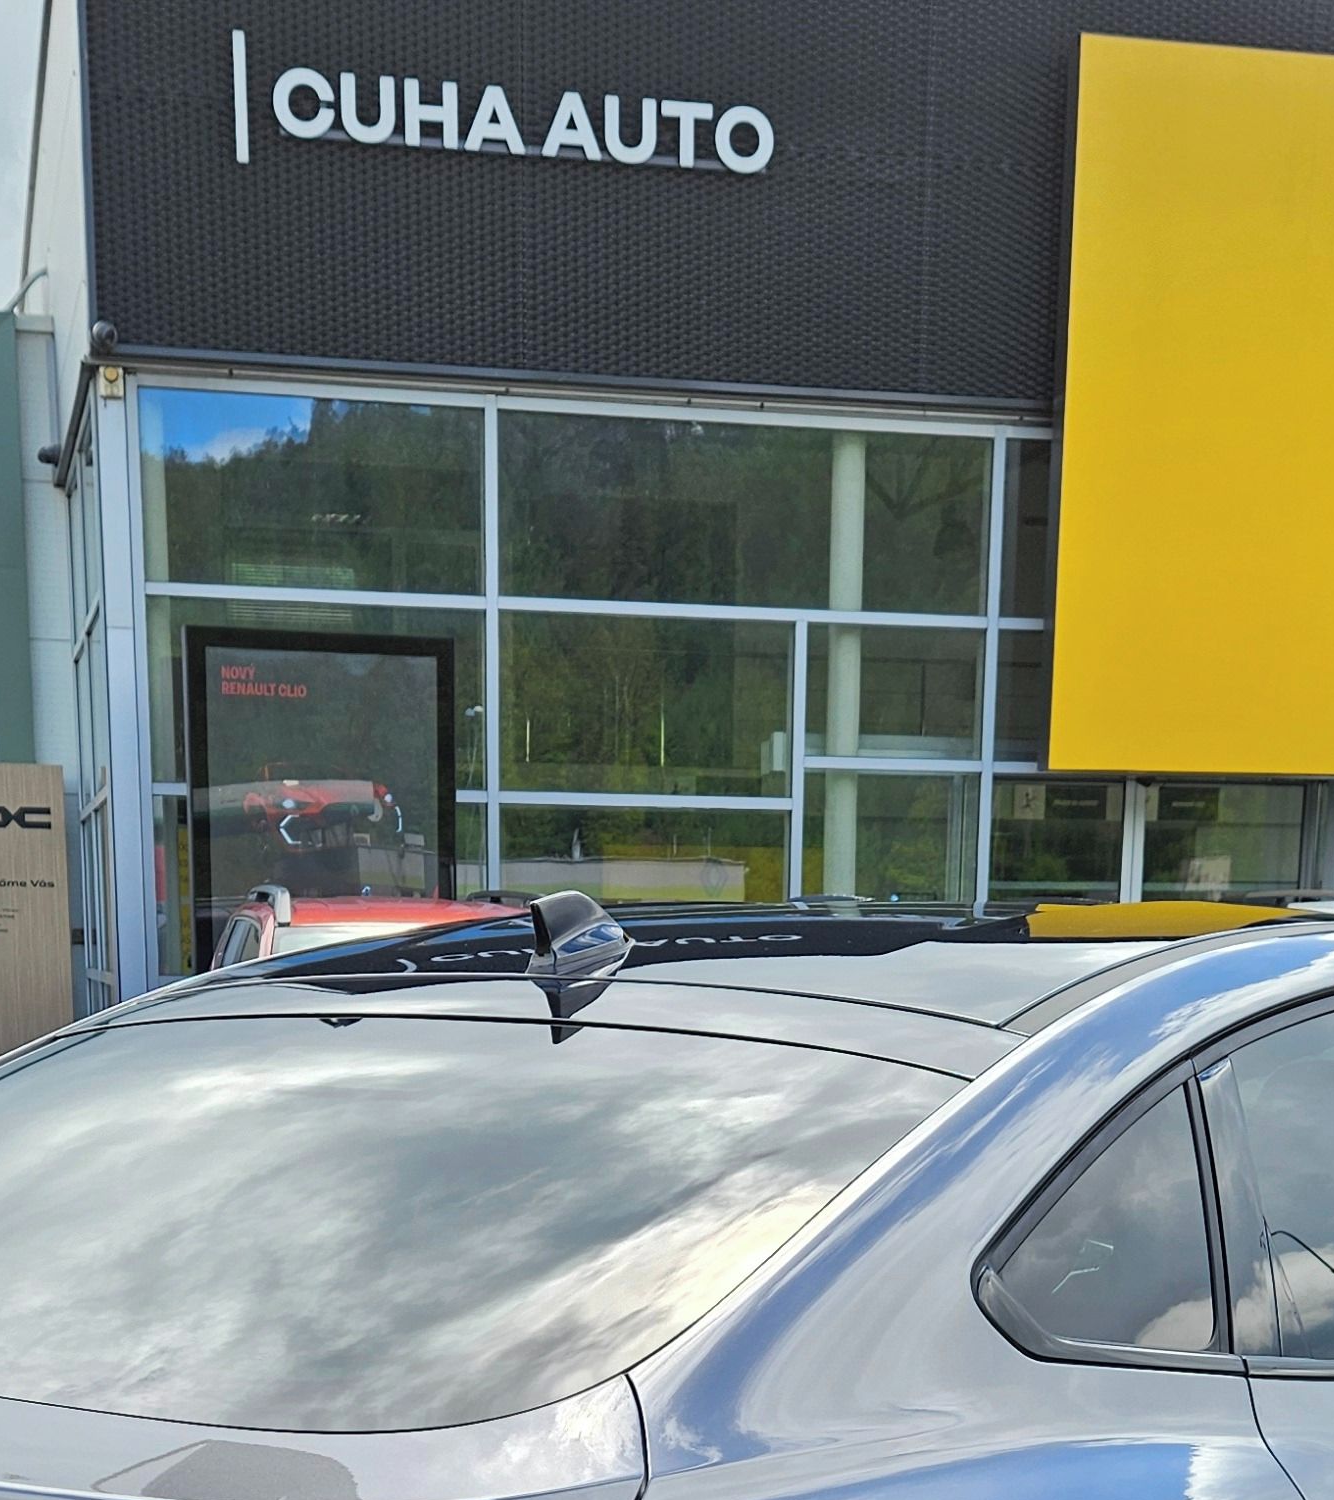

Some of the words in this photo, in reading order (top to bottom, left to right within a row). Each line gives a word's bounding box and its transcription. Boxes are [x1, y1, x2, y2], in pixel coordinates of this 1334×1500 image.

[272, 67, 526, 155] CUHA
[541, 91, 775, 174] AUTO
[221, 663, 255, 679] NOVÝ
[222, 681, 276, 696] RENAULT
[278, 683, 307, 697] CLIO
